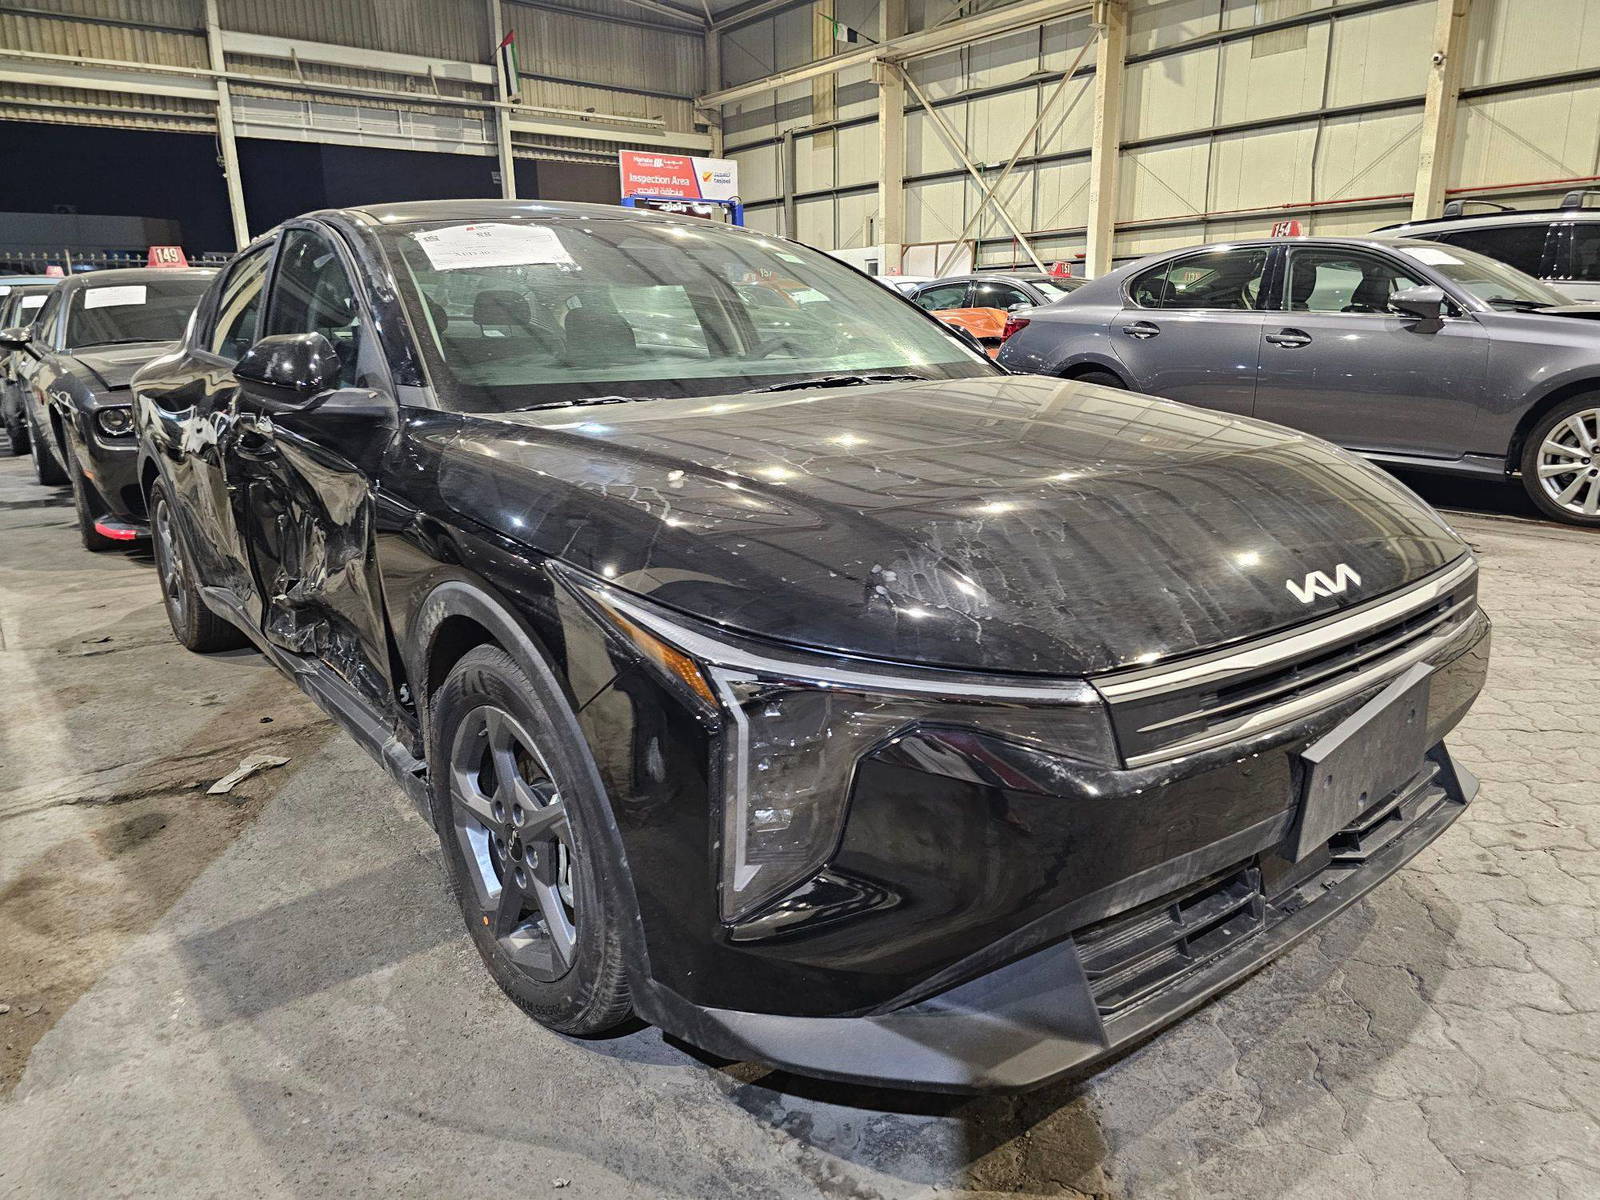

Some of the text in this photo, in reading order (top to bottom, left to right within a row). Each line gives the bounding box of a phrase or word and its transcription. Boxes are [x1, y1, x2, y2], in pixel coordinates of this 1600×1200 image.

[630, 173, 690, 186] Inspection Area
[1274, 222, 1291, 237] 154
[156, 247, 179, 264] 149
